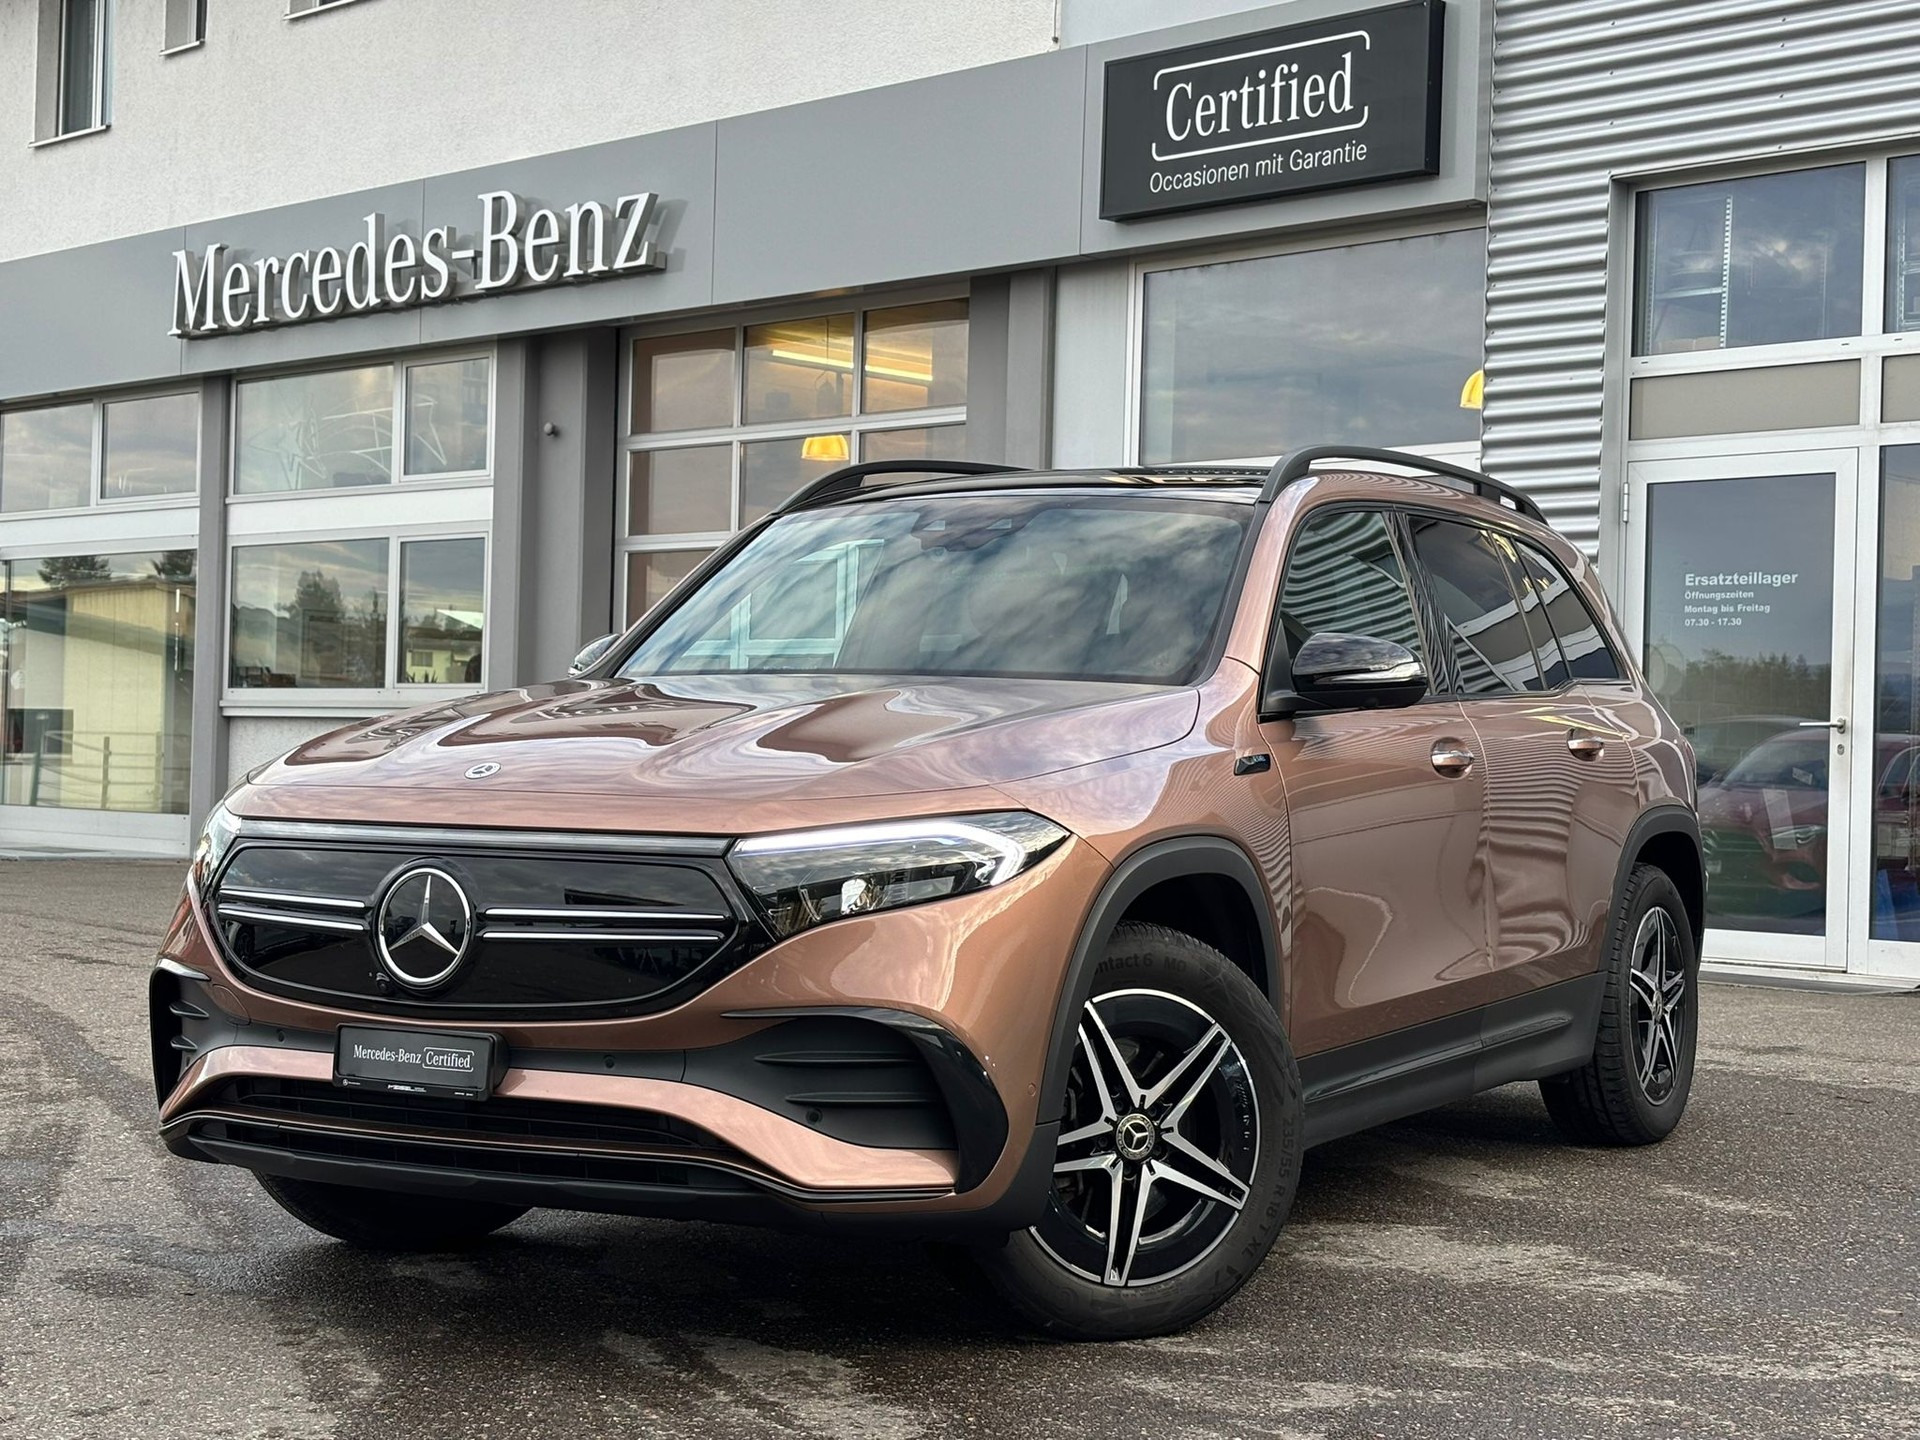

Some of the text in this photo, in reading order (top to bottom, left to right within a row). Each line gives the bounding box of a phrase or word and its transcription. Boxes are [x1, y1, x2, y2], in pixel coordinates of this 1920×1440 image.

[1166, 51, 1354, 142] Certified
[1149, 139, 1367, 193] Occasionen mit Garantie
[167, 189, 661, 337] Mercedes-Benz
[1685, 571, 1798, 587] Ersatzteillager
[1684, 590, 1754, 600] Öffnungszeiten
[1684, 603, 1771, 614] Montag bis Freitag
[1684, 618, 1709, 626] 07.30
[1718, 617, 1742, 626] 17.30
[353, 1044, 471, 1068] Mercedes-Benz Certified
